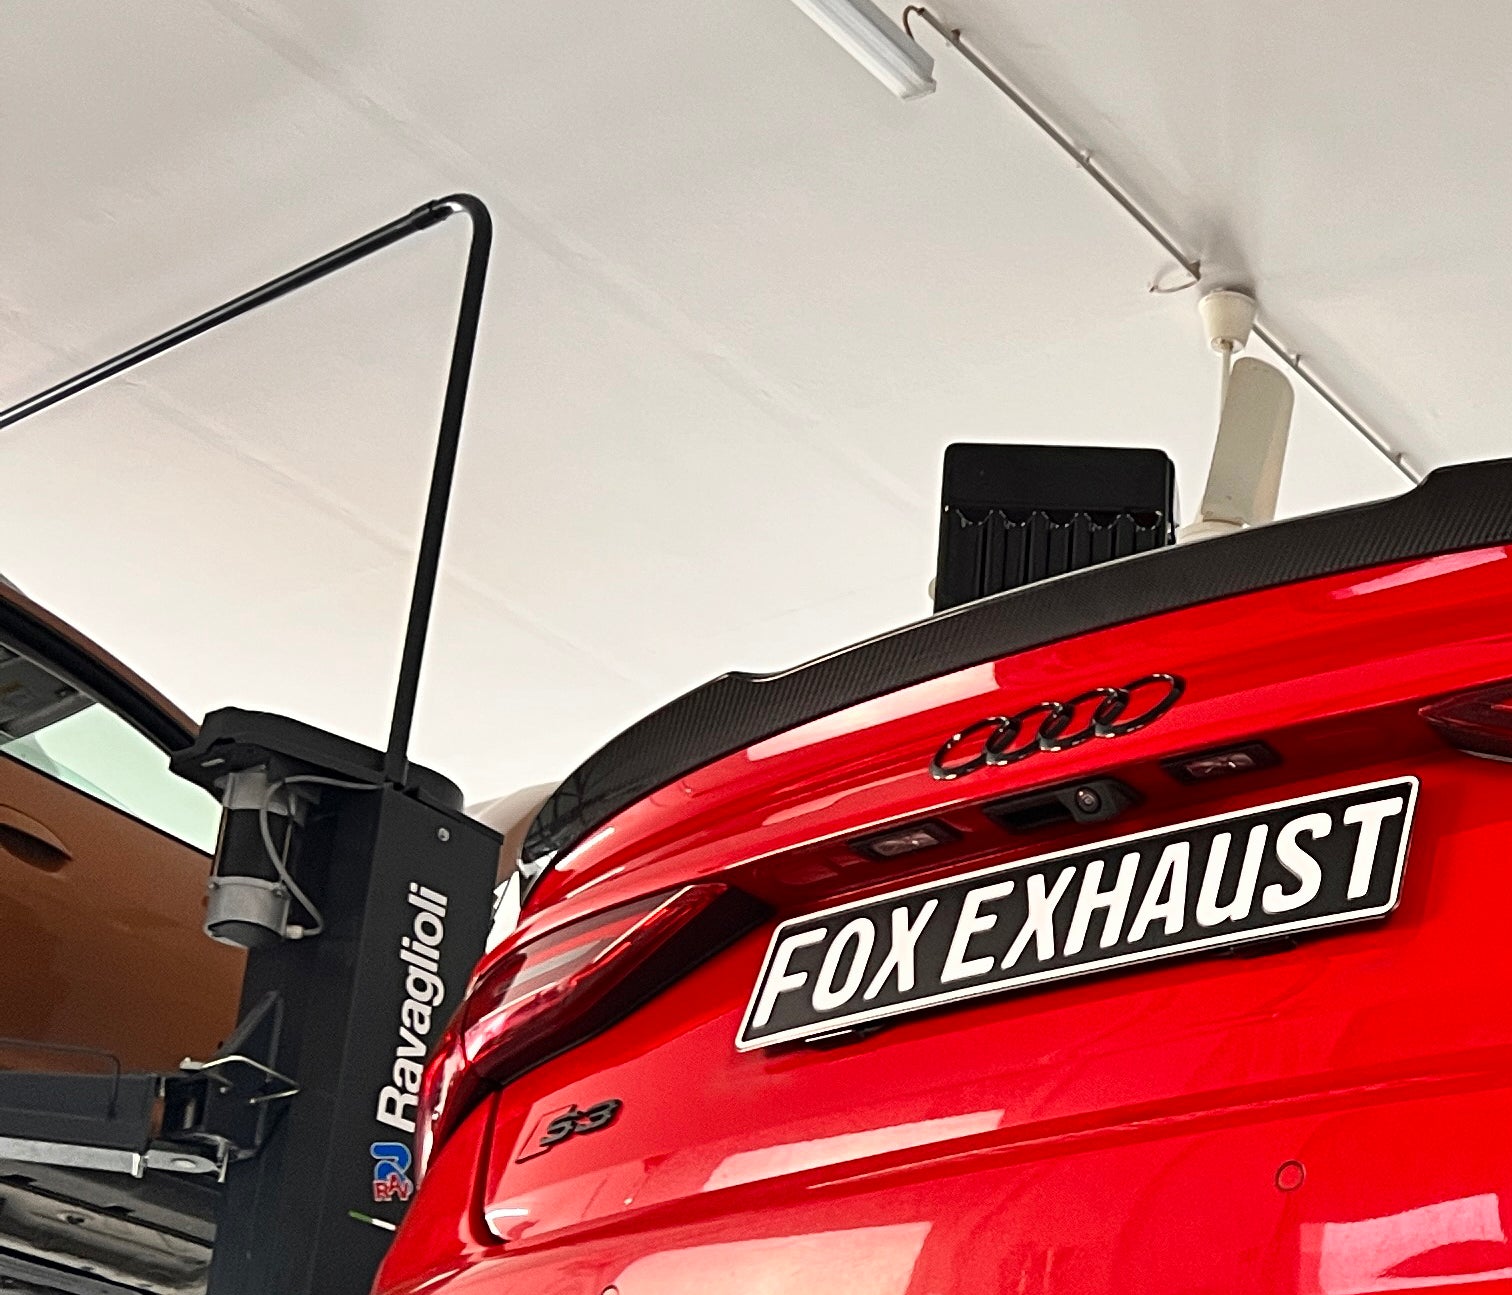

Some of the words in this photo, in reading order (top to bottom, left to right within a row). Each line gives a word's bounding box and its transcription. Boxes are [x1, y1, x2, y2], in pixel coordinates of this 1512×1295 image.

[376, 881, 449, 1133] Ravaglioli
[751, 899, 938, 1028] FOX
[941, 797, 1404, 984] EXHAUST
[540, 1099, 622, 1147] S3
